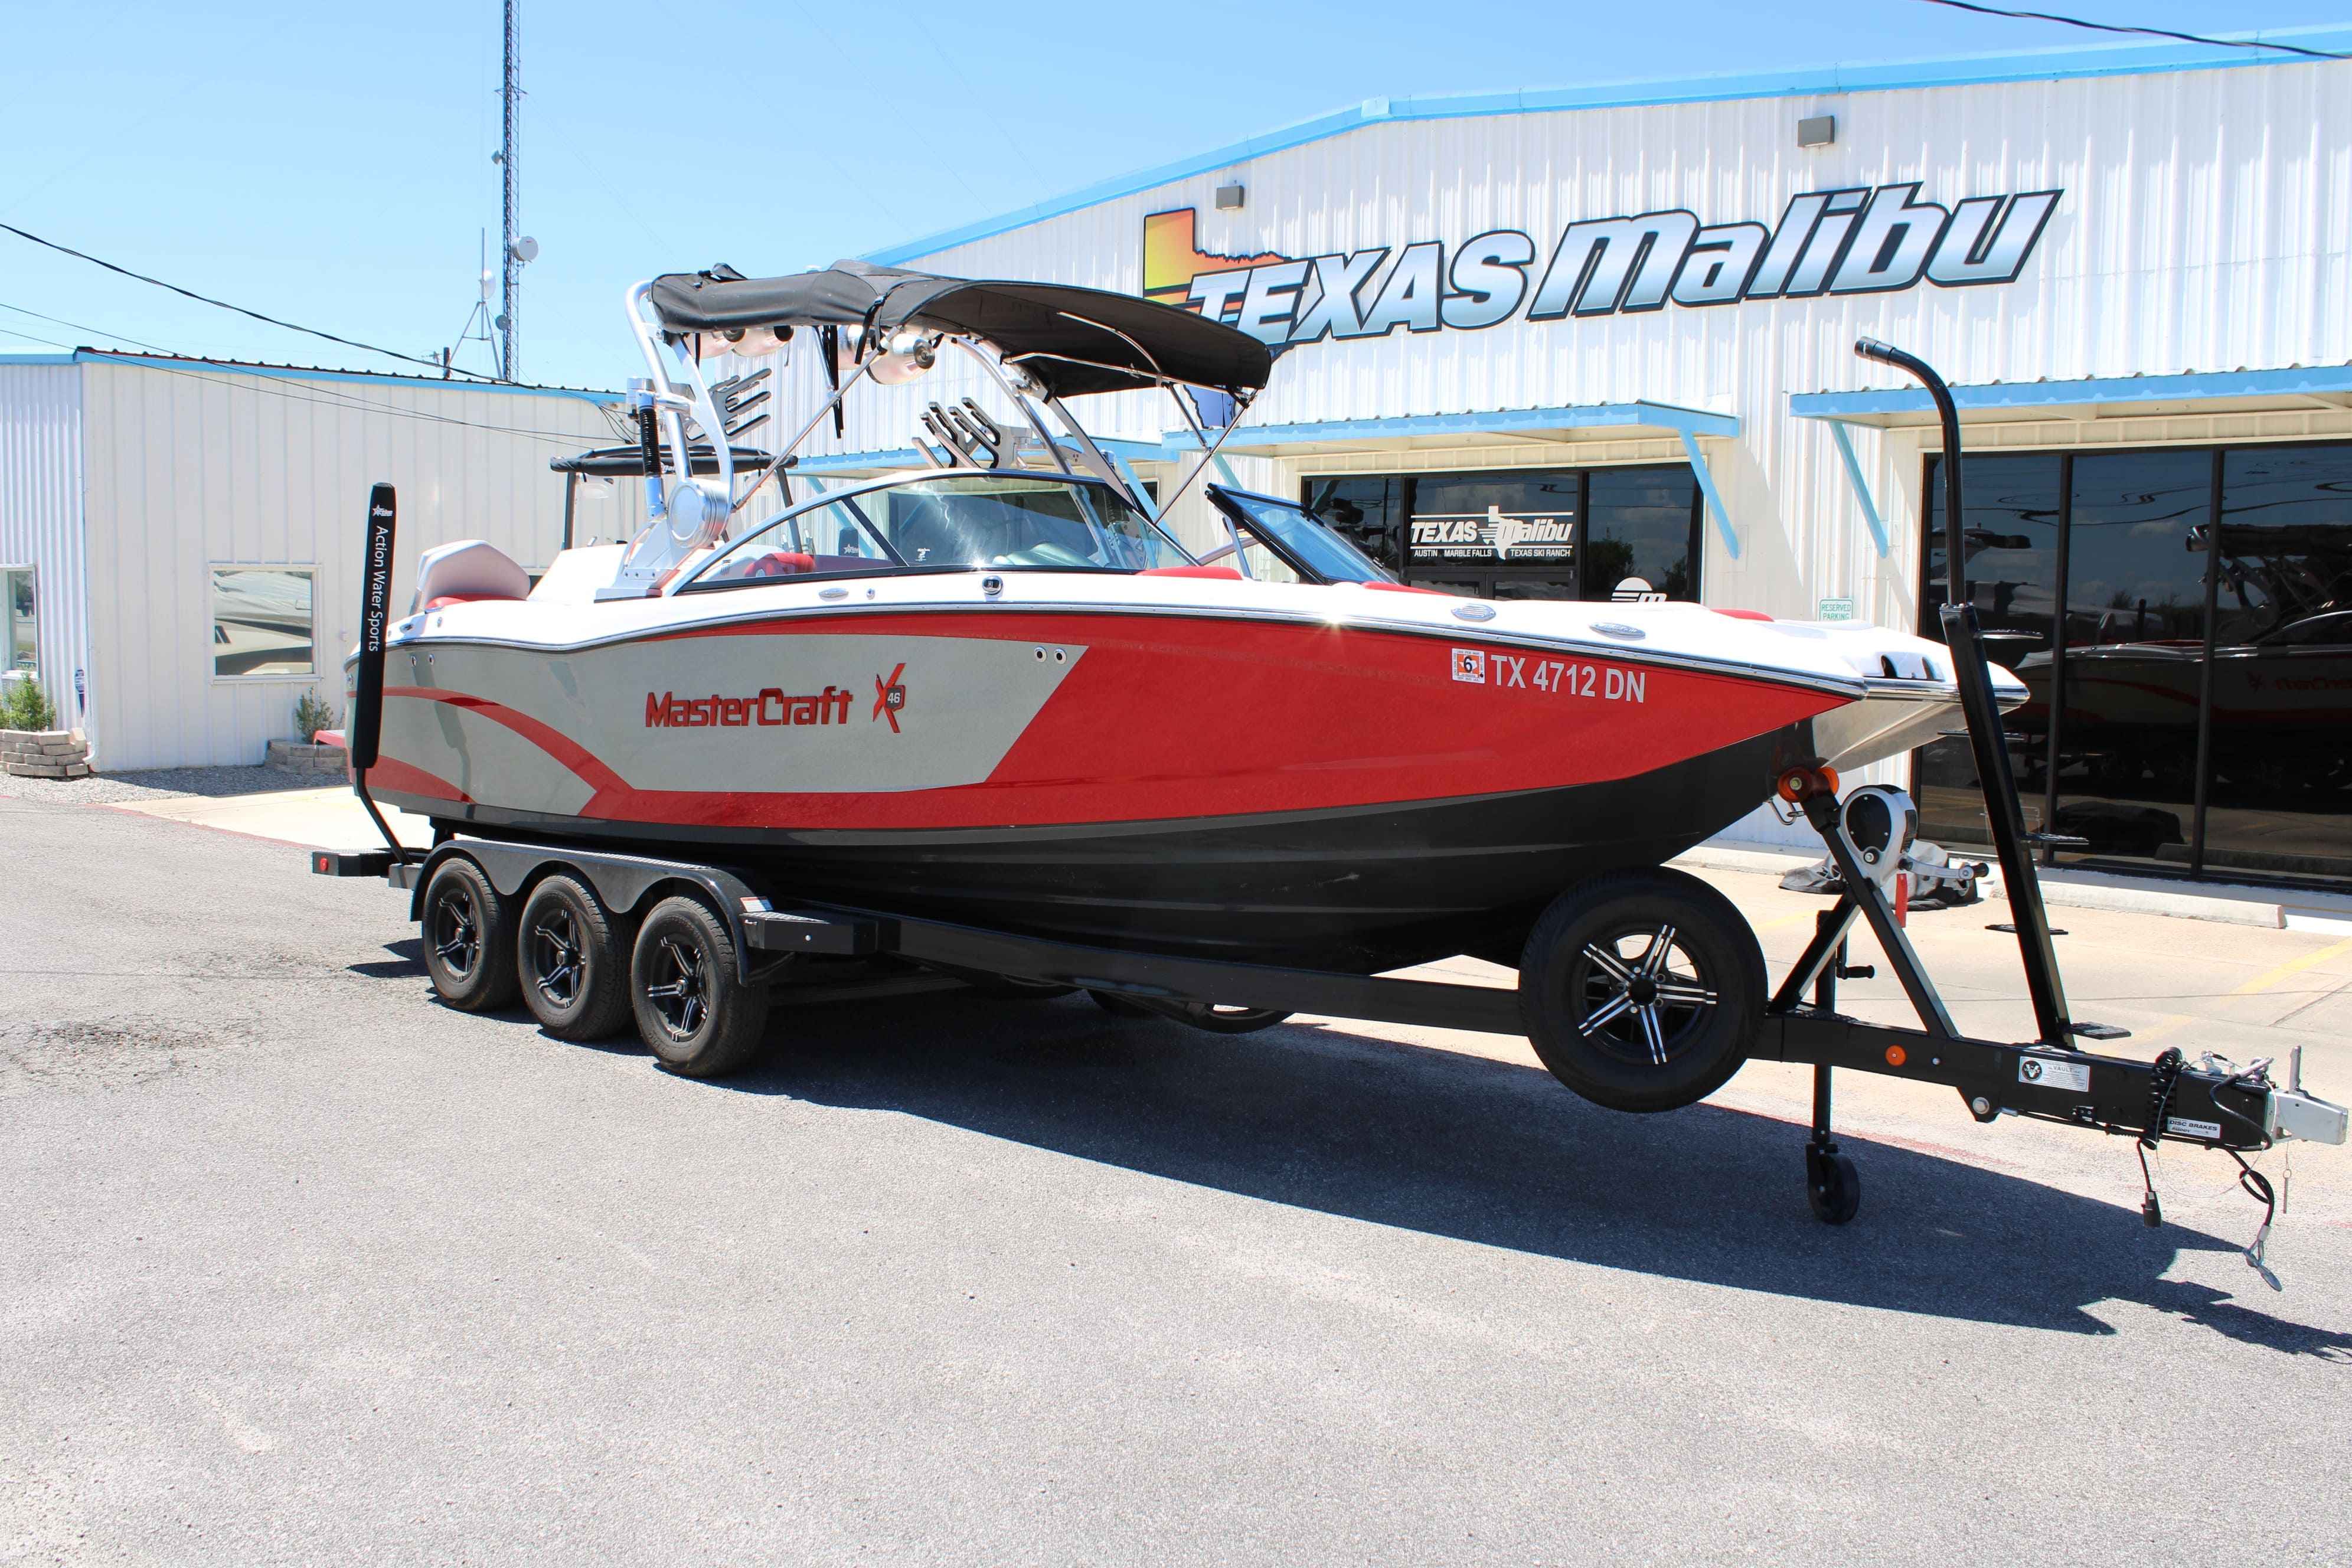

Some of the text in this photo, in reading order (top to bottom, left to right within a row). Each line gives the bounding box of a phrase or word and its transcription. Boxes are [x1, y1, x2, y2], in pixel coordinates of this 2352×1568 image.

[1187, 230, 1536, 346] TEXAS
[374, 525, 388, 567] Action
[1410, 521, 1478, 543] TEXAS
[371, 571, 386, 609] Water
[368, 610, 383, 652] Sports
[1464, 656, 1472, 672] 6
[1491, 655, 1526, 688] TX
[1533, 660, 1596, 697] 4712
[1605, 668, 1645, 703] DN
[645, 685, 854, 727] MasterCraft
